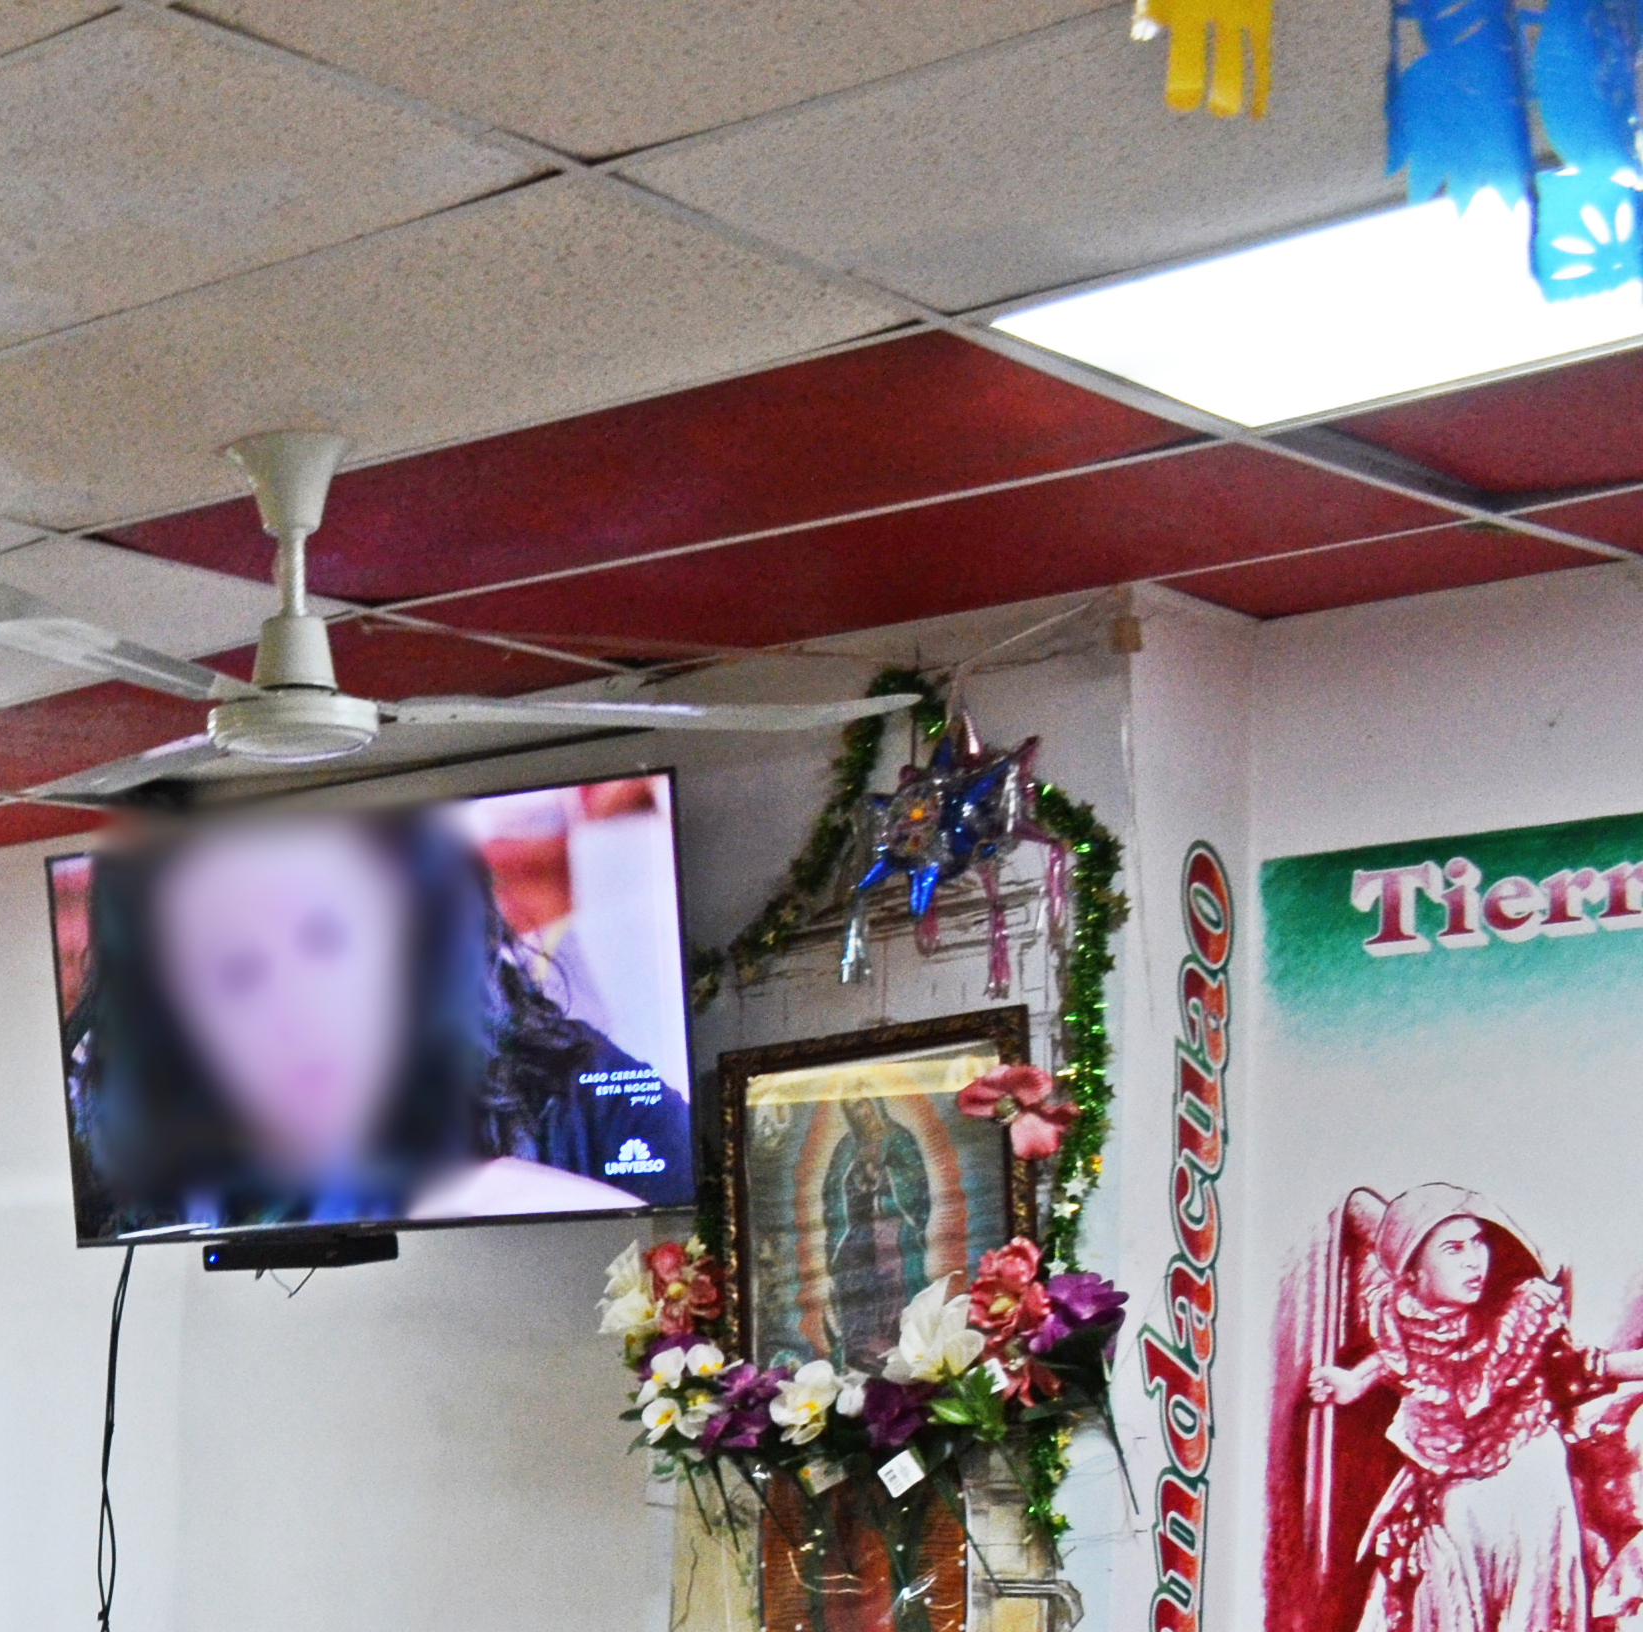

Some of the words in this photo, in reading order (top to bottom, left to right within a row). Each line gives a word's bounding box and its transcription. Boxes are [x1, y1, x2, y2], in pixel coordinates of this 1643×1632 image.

[579, 1072, 609, 1084] CASO
[610, 1068, 660, 1082] CERRADO
[596, 1084, 622, 1097] ESTA
[623, 1081, 662, 1094] NOCHE
[604, 1159, 666, 1176] UNIVERSO
